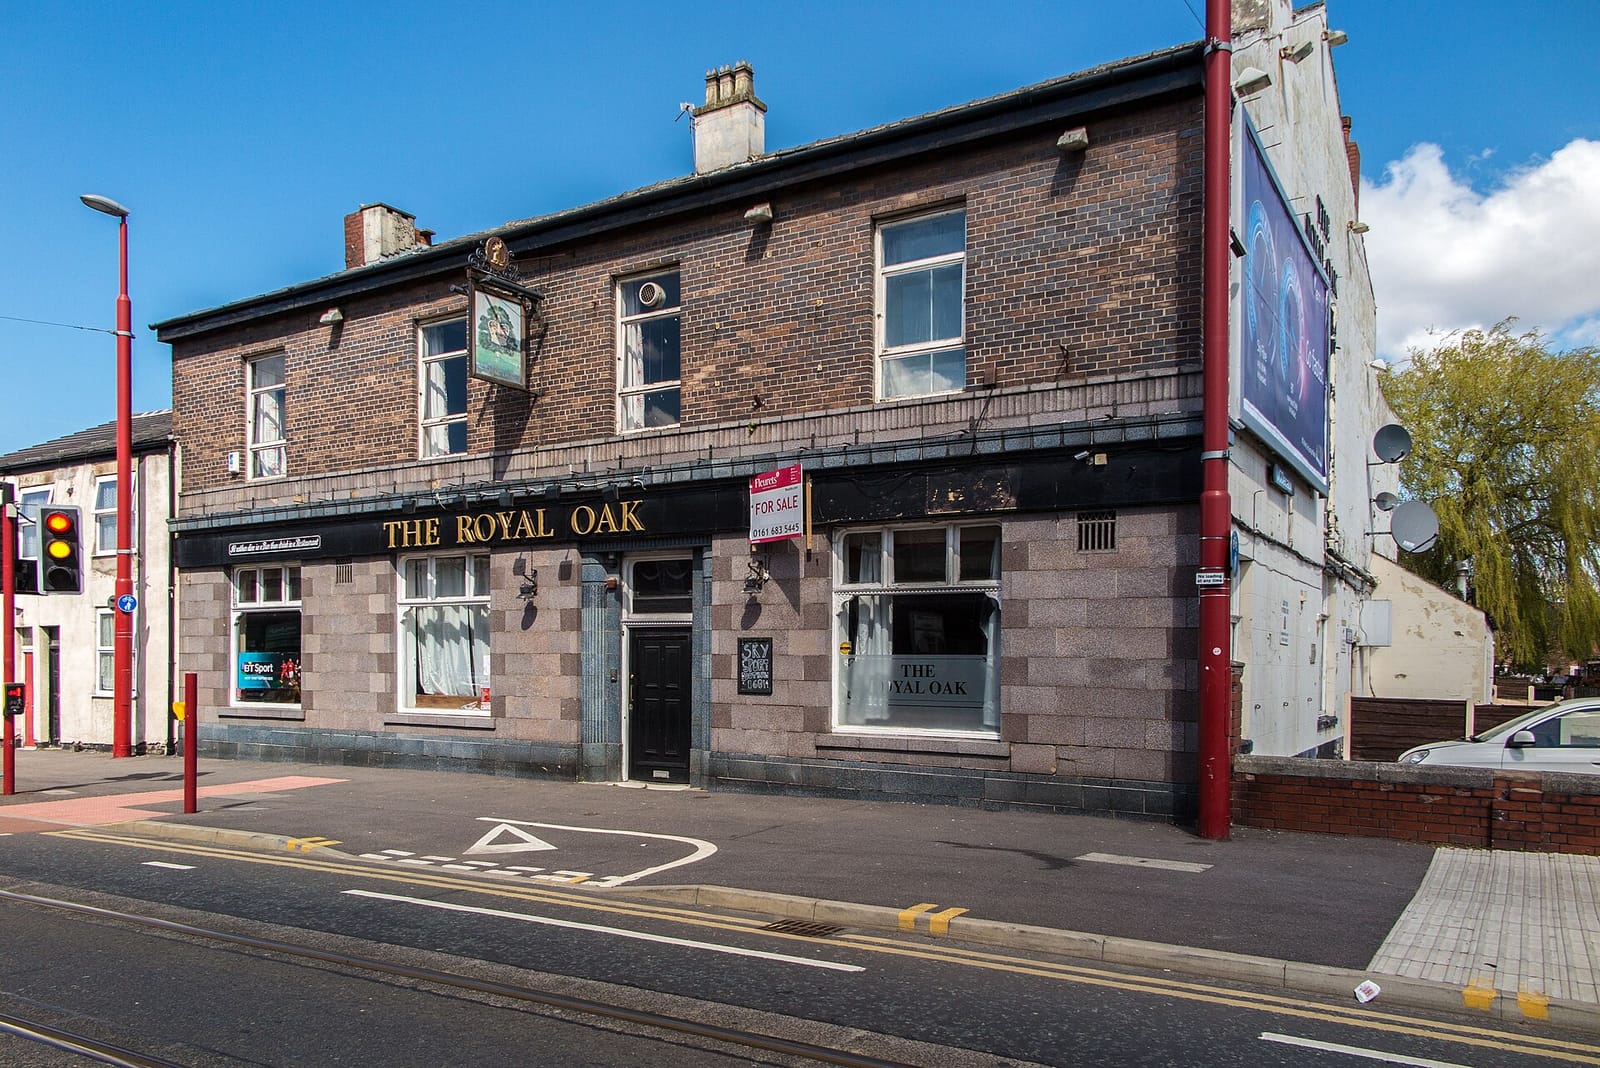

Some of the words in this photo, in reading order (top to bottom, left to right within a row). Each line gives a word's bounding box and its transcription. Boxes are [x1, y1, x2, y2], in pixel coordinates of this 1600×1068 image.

[755, 500, 774, 516] FOR
[776, 495, 798, 512] SALE
[383, 517, 441, 549] THE
[456, 508, 554, 544] ROYAL
[570, 499, 645, 535] OAK
[753, 528, 769, 537] 0161
[771, 525, 783, 536] 683
[784, 522, 800, 533] 5445
[742, 643, 769, 659] SKY
[244, 664, 254, 672] BT
[254, 663, 274, 674] Sport
[901, 664, 936, 678] THE
[929, 681, 967, 695] OAK
